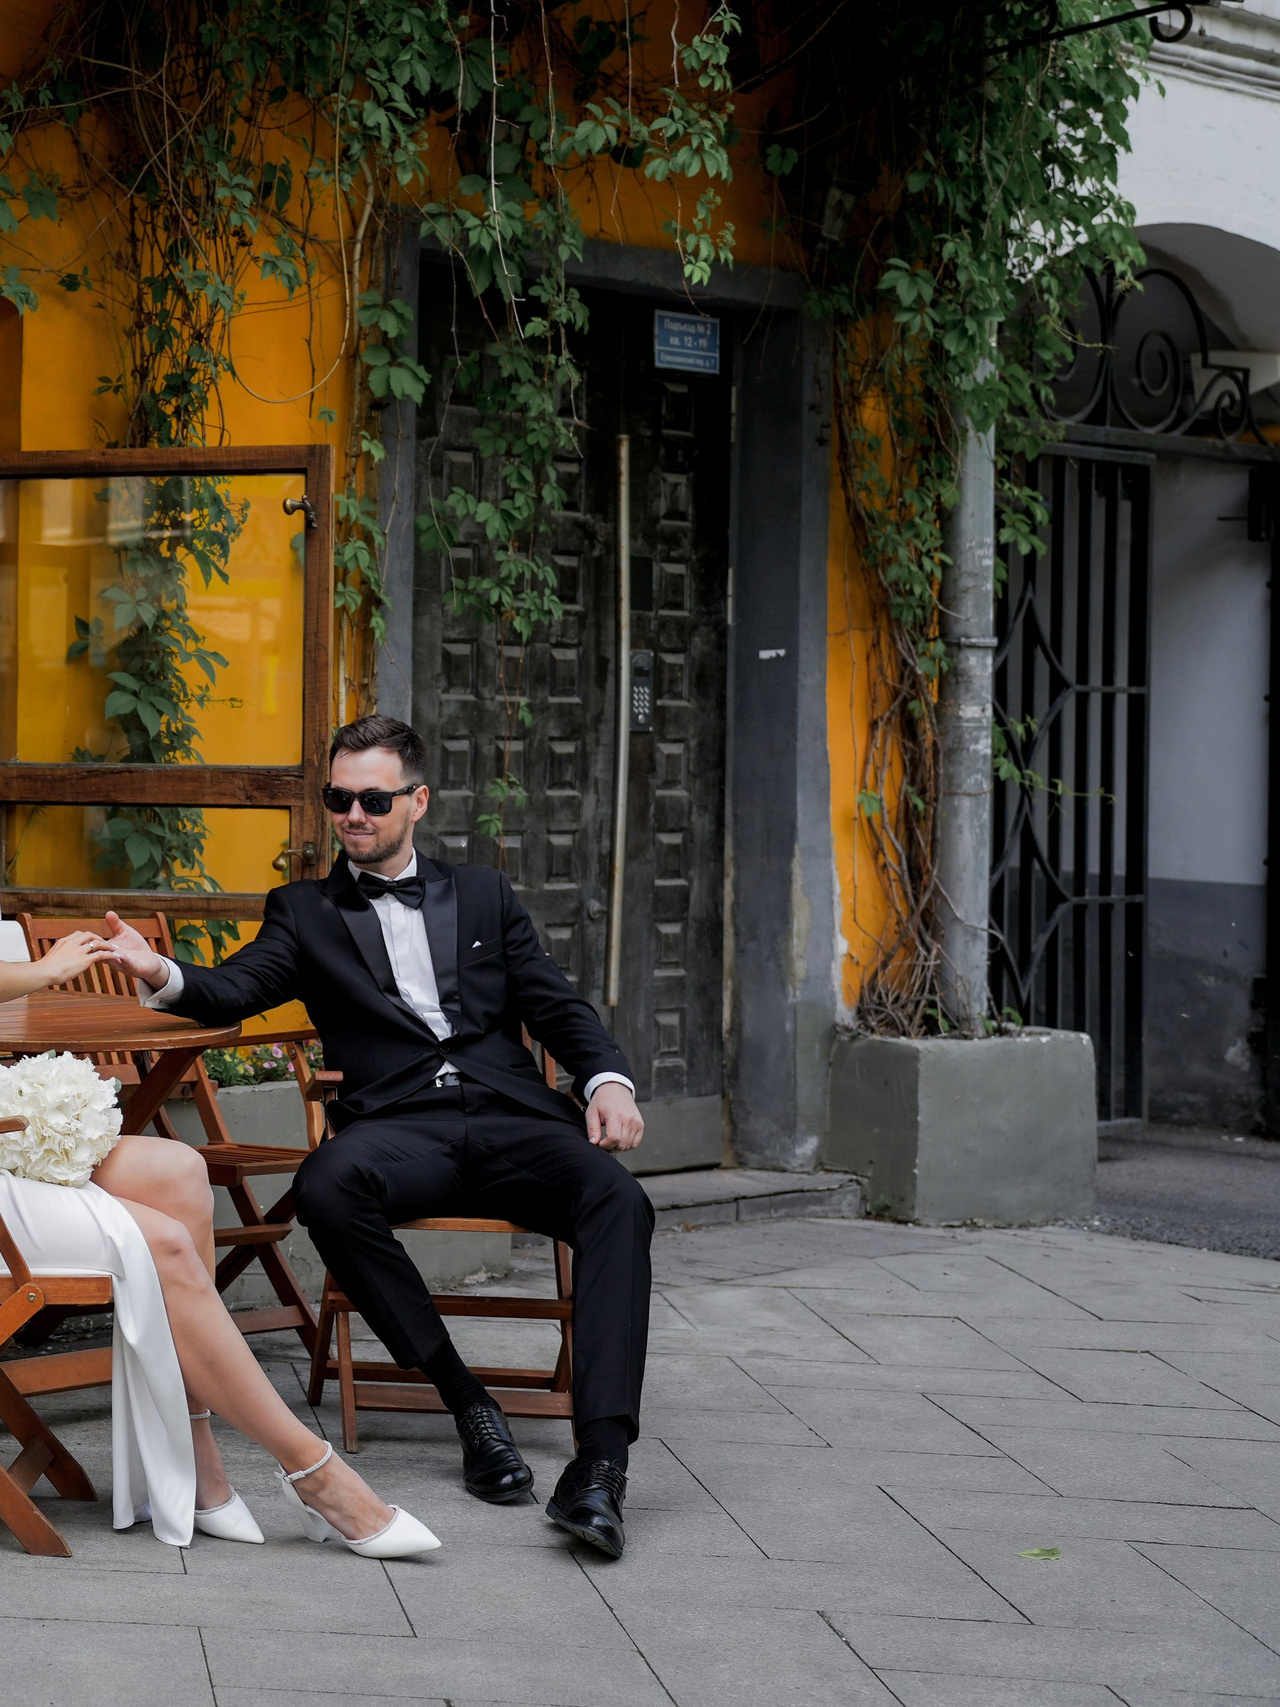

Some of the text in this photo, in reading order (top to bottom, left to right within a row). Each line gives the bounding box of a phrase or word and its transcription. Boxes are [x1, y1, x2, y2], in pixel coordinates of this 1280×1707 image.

[663, 318, 696, 334] Подъезд
[697, 323, 705, 334] №
[684, 336, 693, 348] 12
